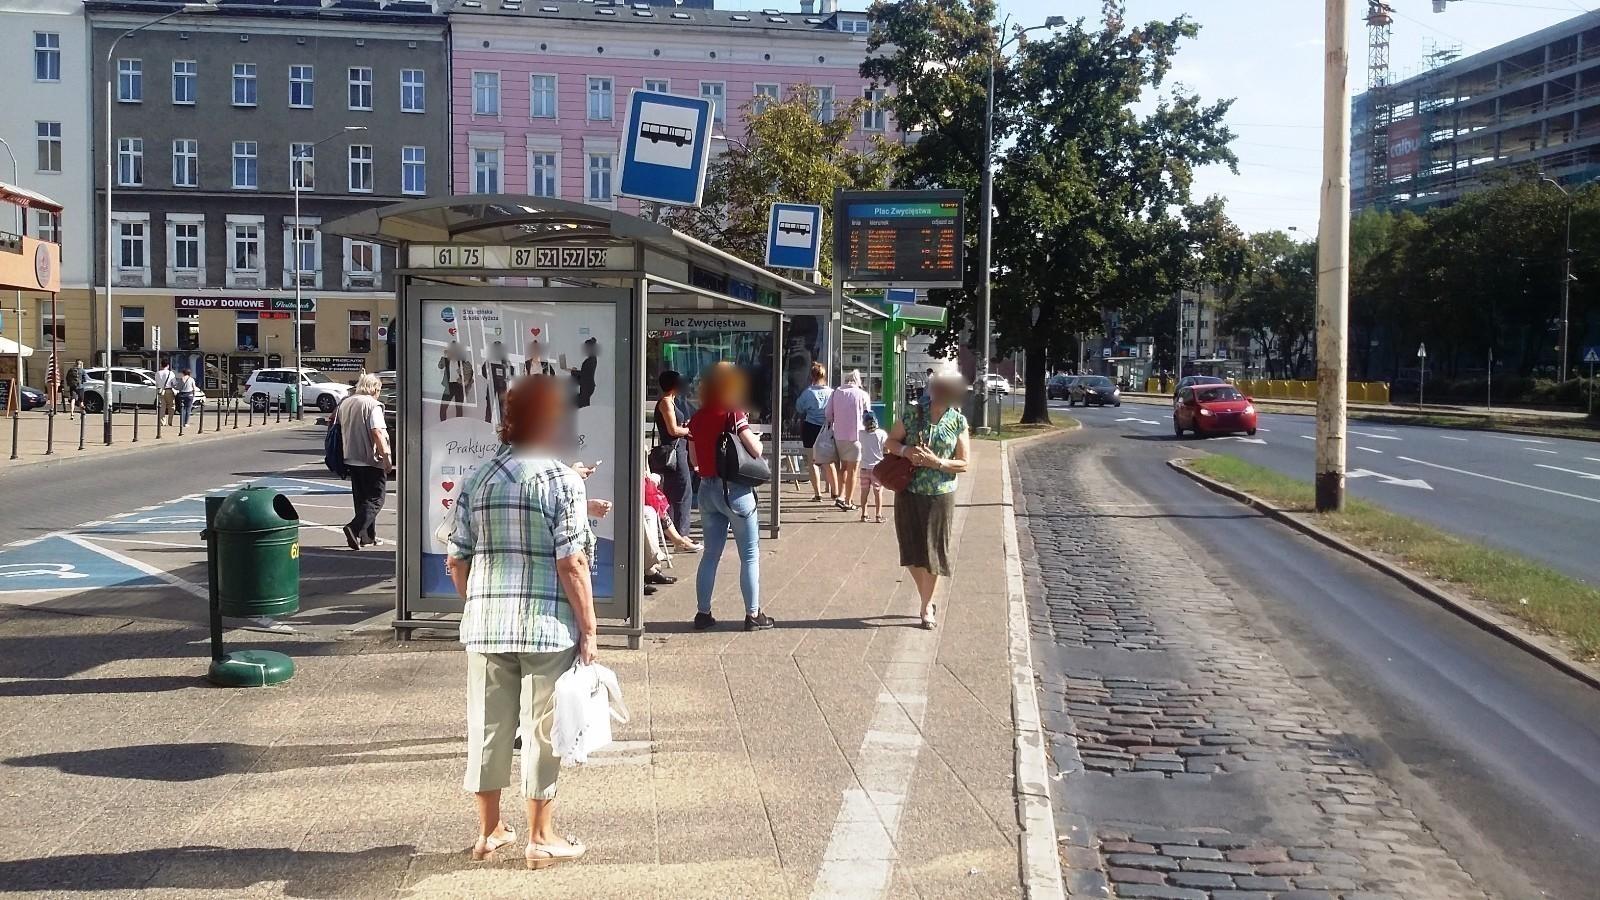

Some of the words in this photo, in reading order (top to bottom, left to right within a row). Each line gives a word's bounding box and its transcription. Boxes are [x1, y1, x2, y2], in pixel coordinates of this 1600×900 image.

[874, 207, 890, 215] Plac
[891, 207, 932, 216] Zwycięstwa
[438, 248, 452, 265] 61
[464, 248, 479, 265] 75
[515, 249, 531, 266] 87
[537, 250, 557, 267] 521
[563, 250, 584, 267] 527
[181, 298, 218, 307] OBIADY
[220, 299, 265, 308] DOMOWE
[664, 317, 685, 328] Plac
[686, 317, 747, 331] Zwycięstwa
[446, 438, 499, 458] Praktycz
